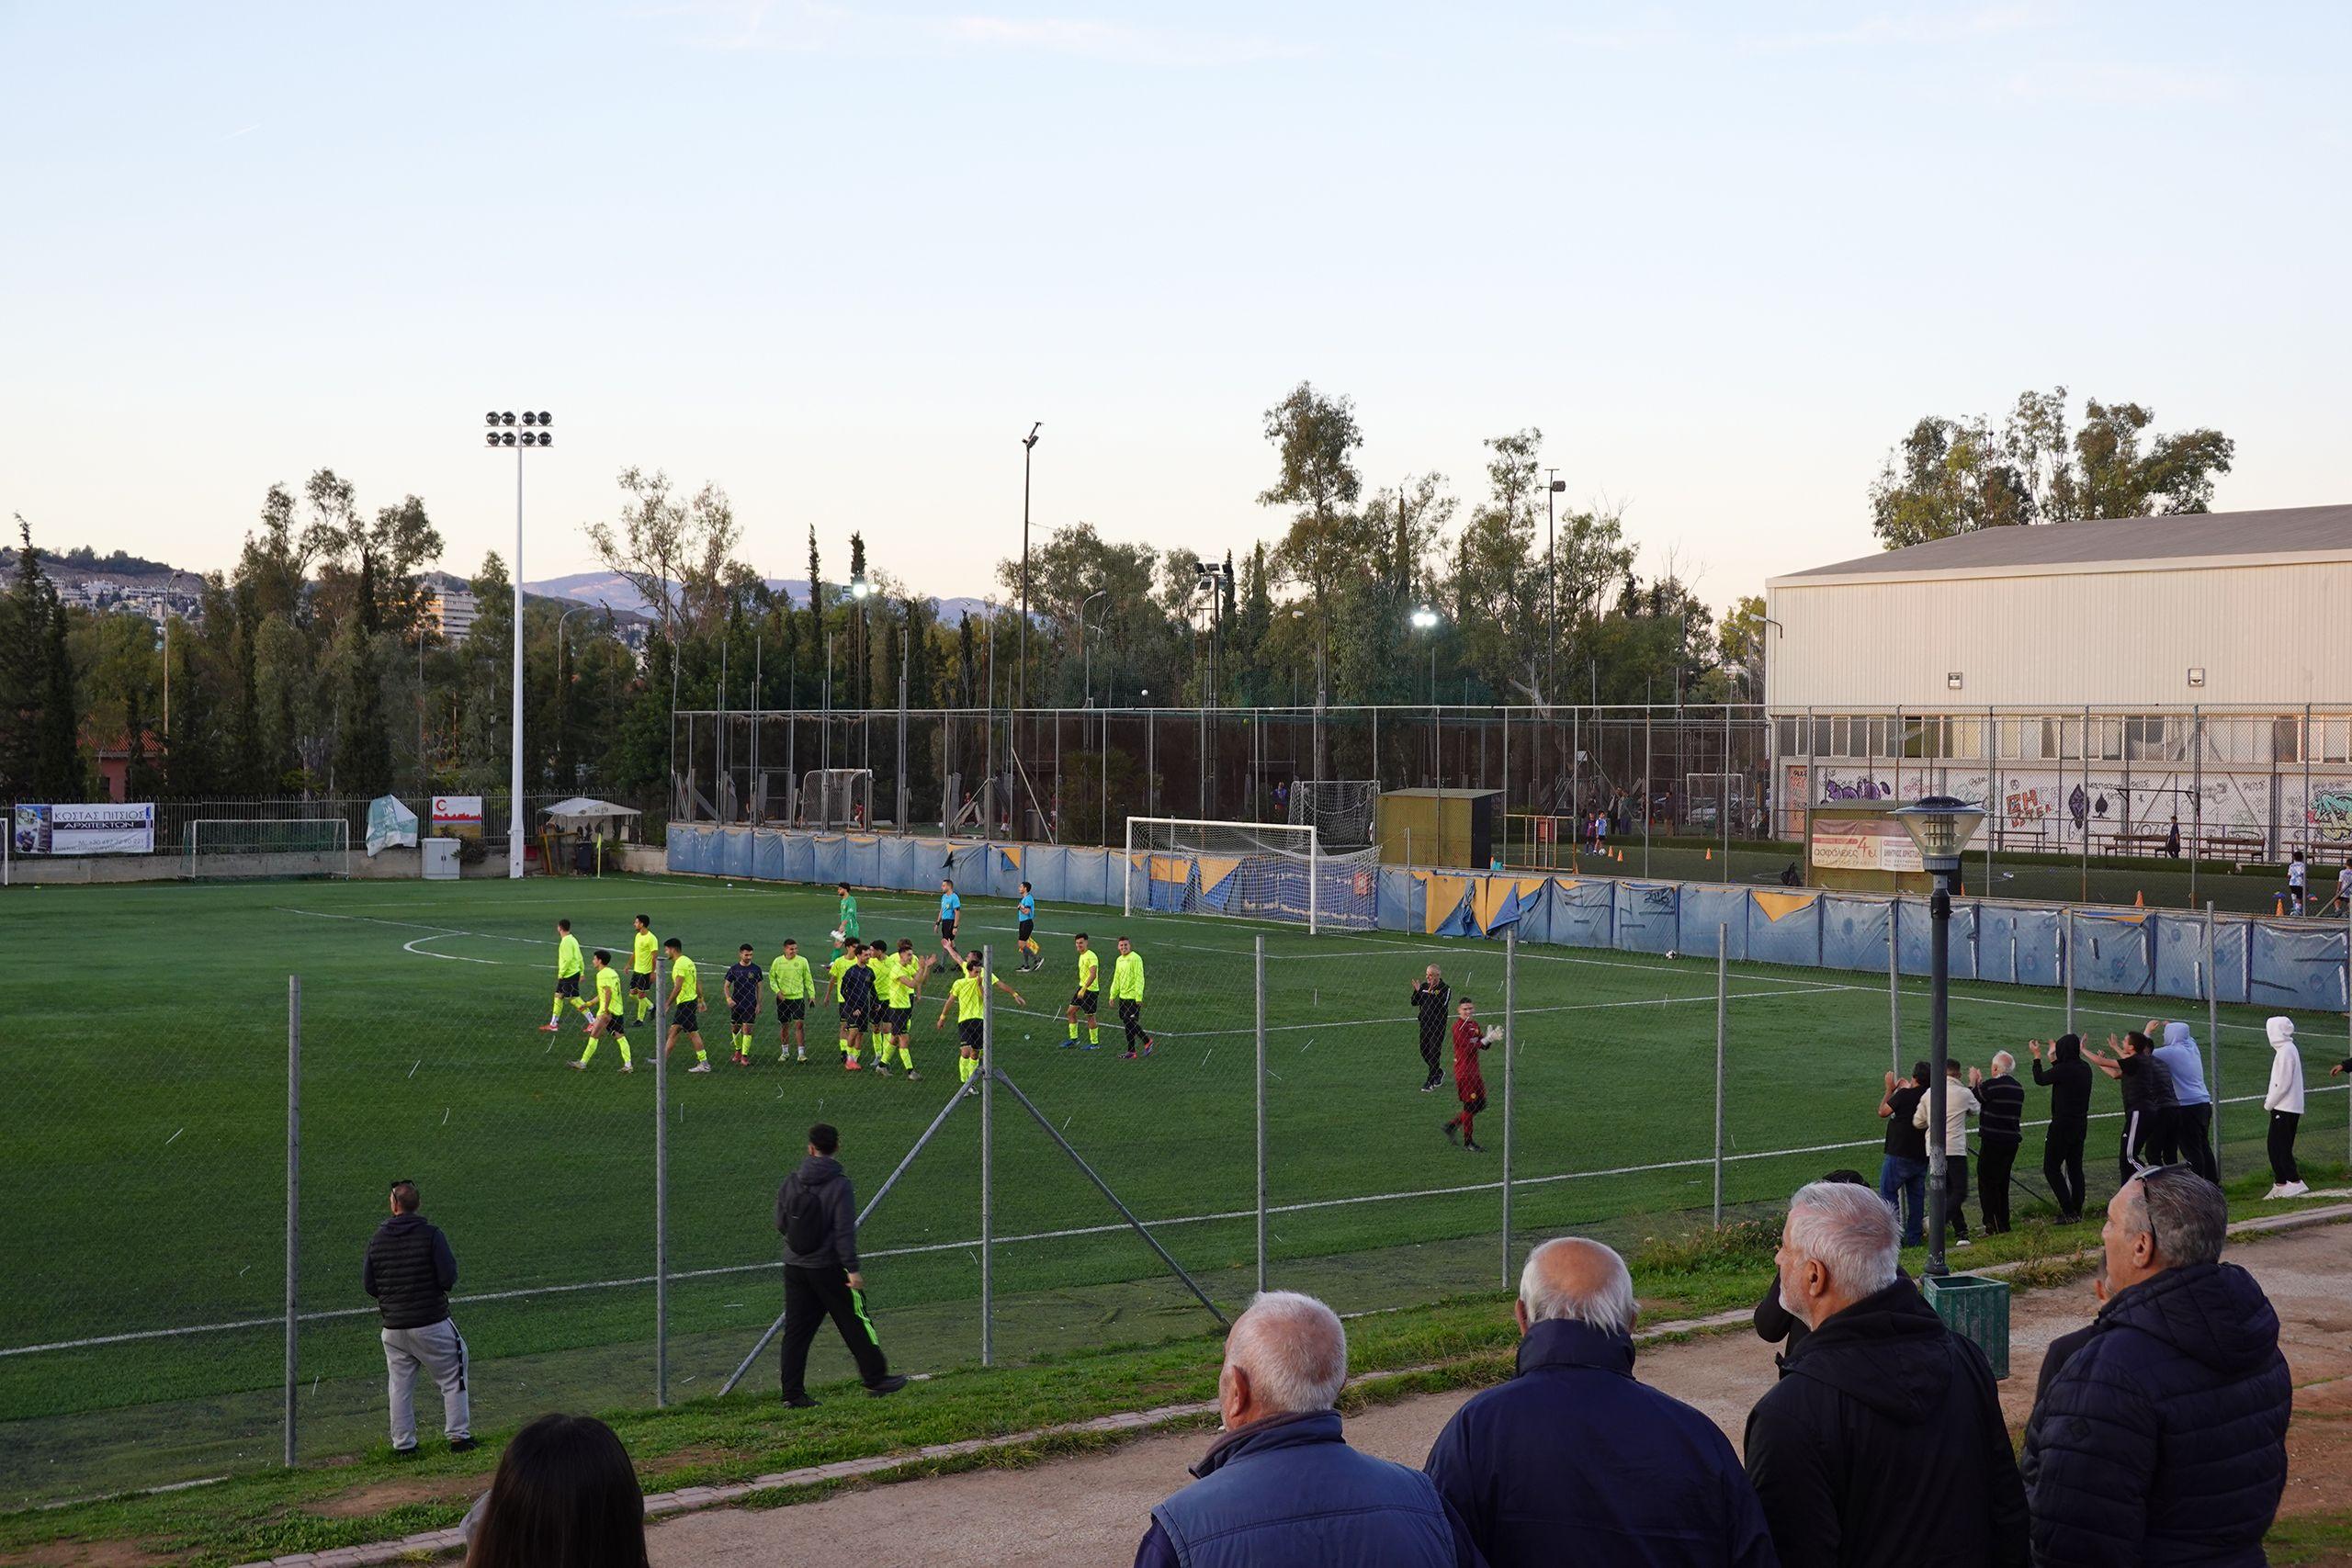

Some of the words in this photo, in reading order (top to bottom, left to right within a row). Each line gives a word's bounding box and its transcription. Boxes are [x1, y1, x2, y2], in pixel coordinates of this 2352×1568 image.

[54, 811, 99, 820] ΚΩΣΤΑΣ
[103, 810, 144, 819] ΠΙΤΣΙΟΣ
[1814, 848, 1858, 858] ασφάλειες
